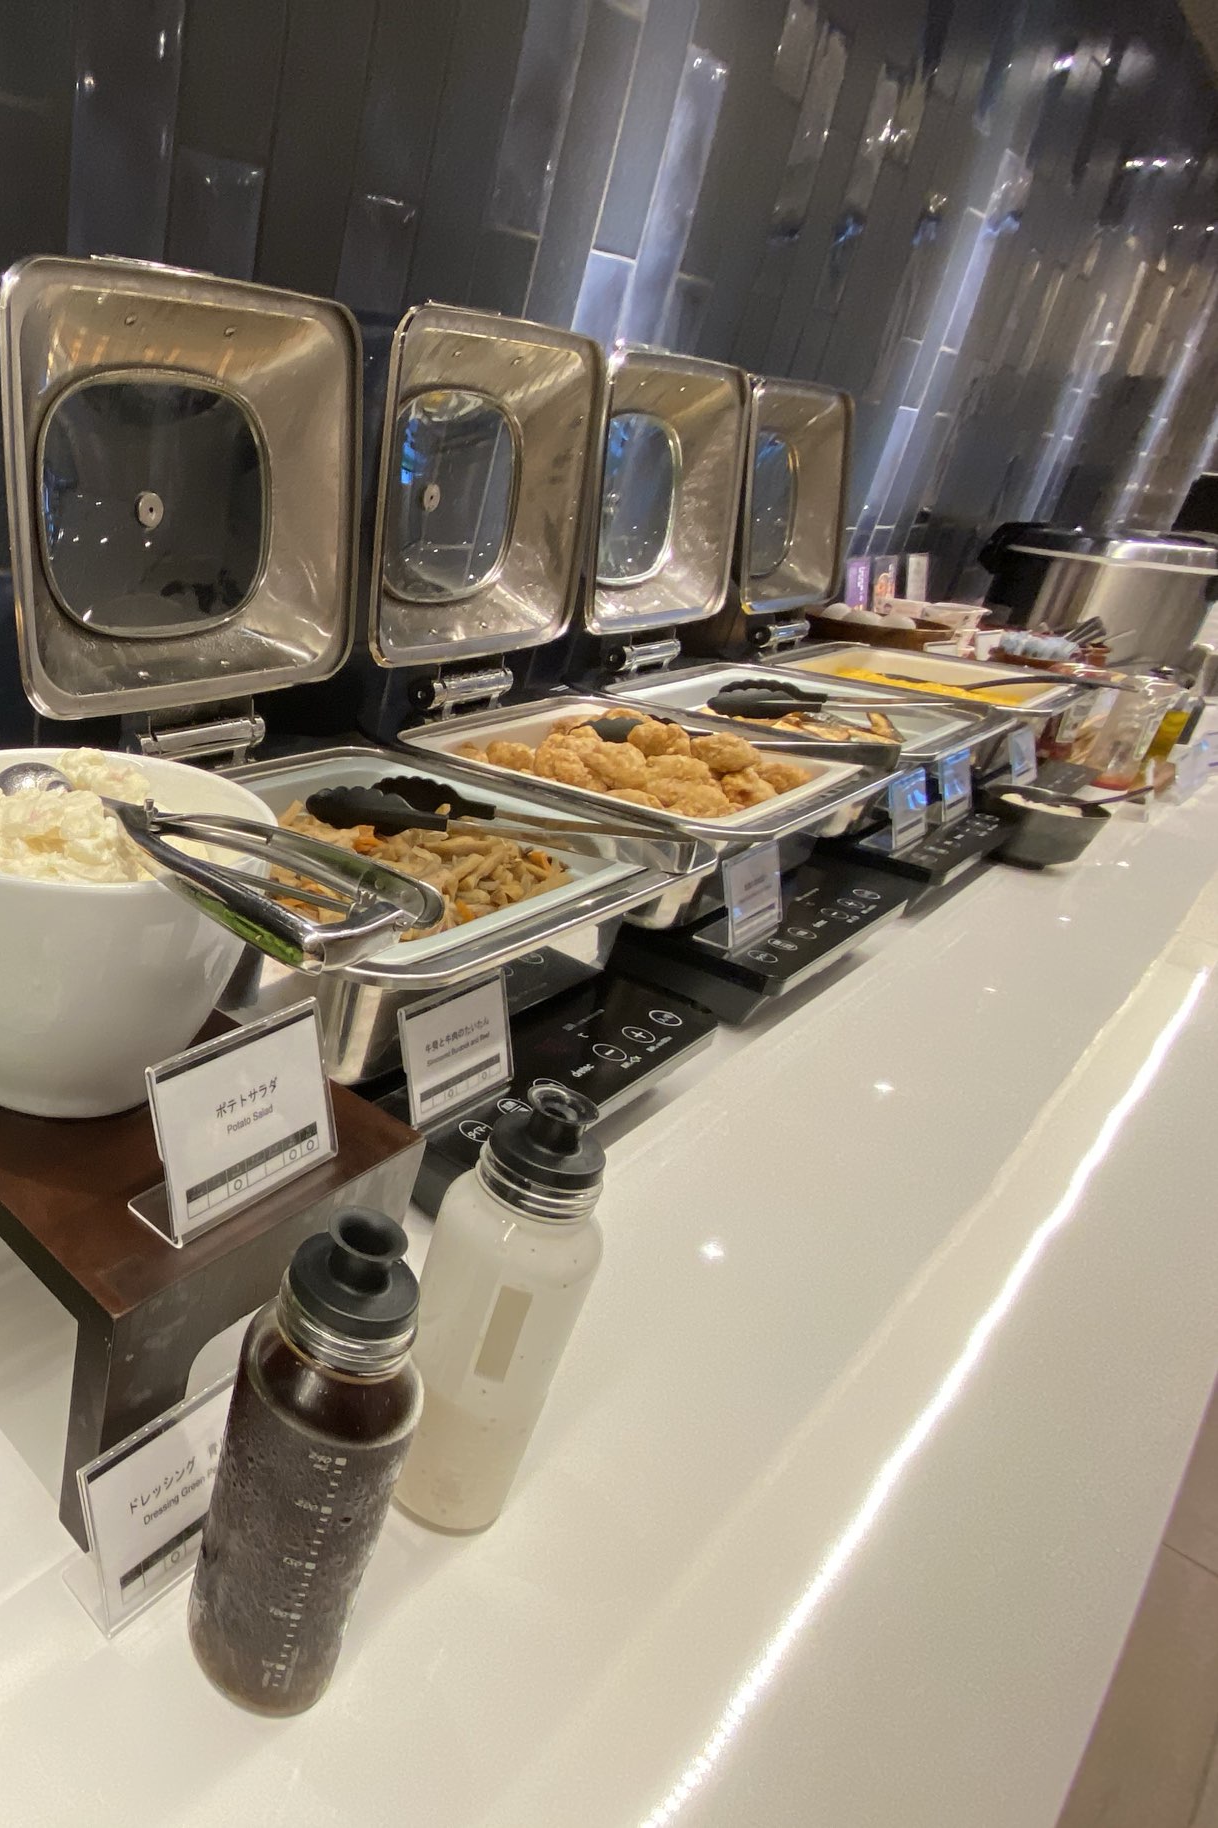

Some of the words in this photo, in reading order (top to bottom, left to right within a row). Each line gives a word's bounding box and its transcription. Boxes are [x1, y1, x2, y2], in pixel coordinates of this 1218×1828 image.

[215, 1076, 278, 1119] ポテトサラダ
[227, 1116, 251, 1135] Potato
[252, 1103, 274, 1121] Salad
[129, 1455, 196, 1515] ドレッシング
[143, 1494, 180, 1526] Dressing
[181, 1476, 205, 1497] Green
